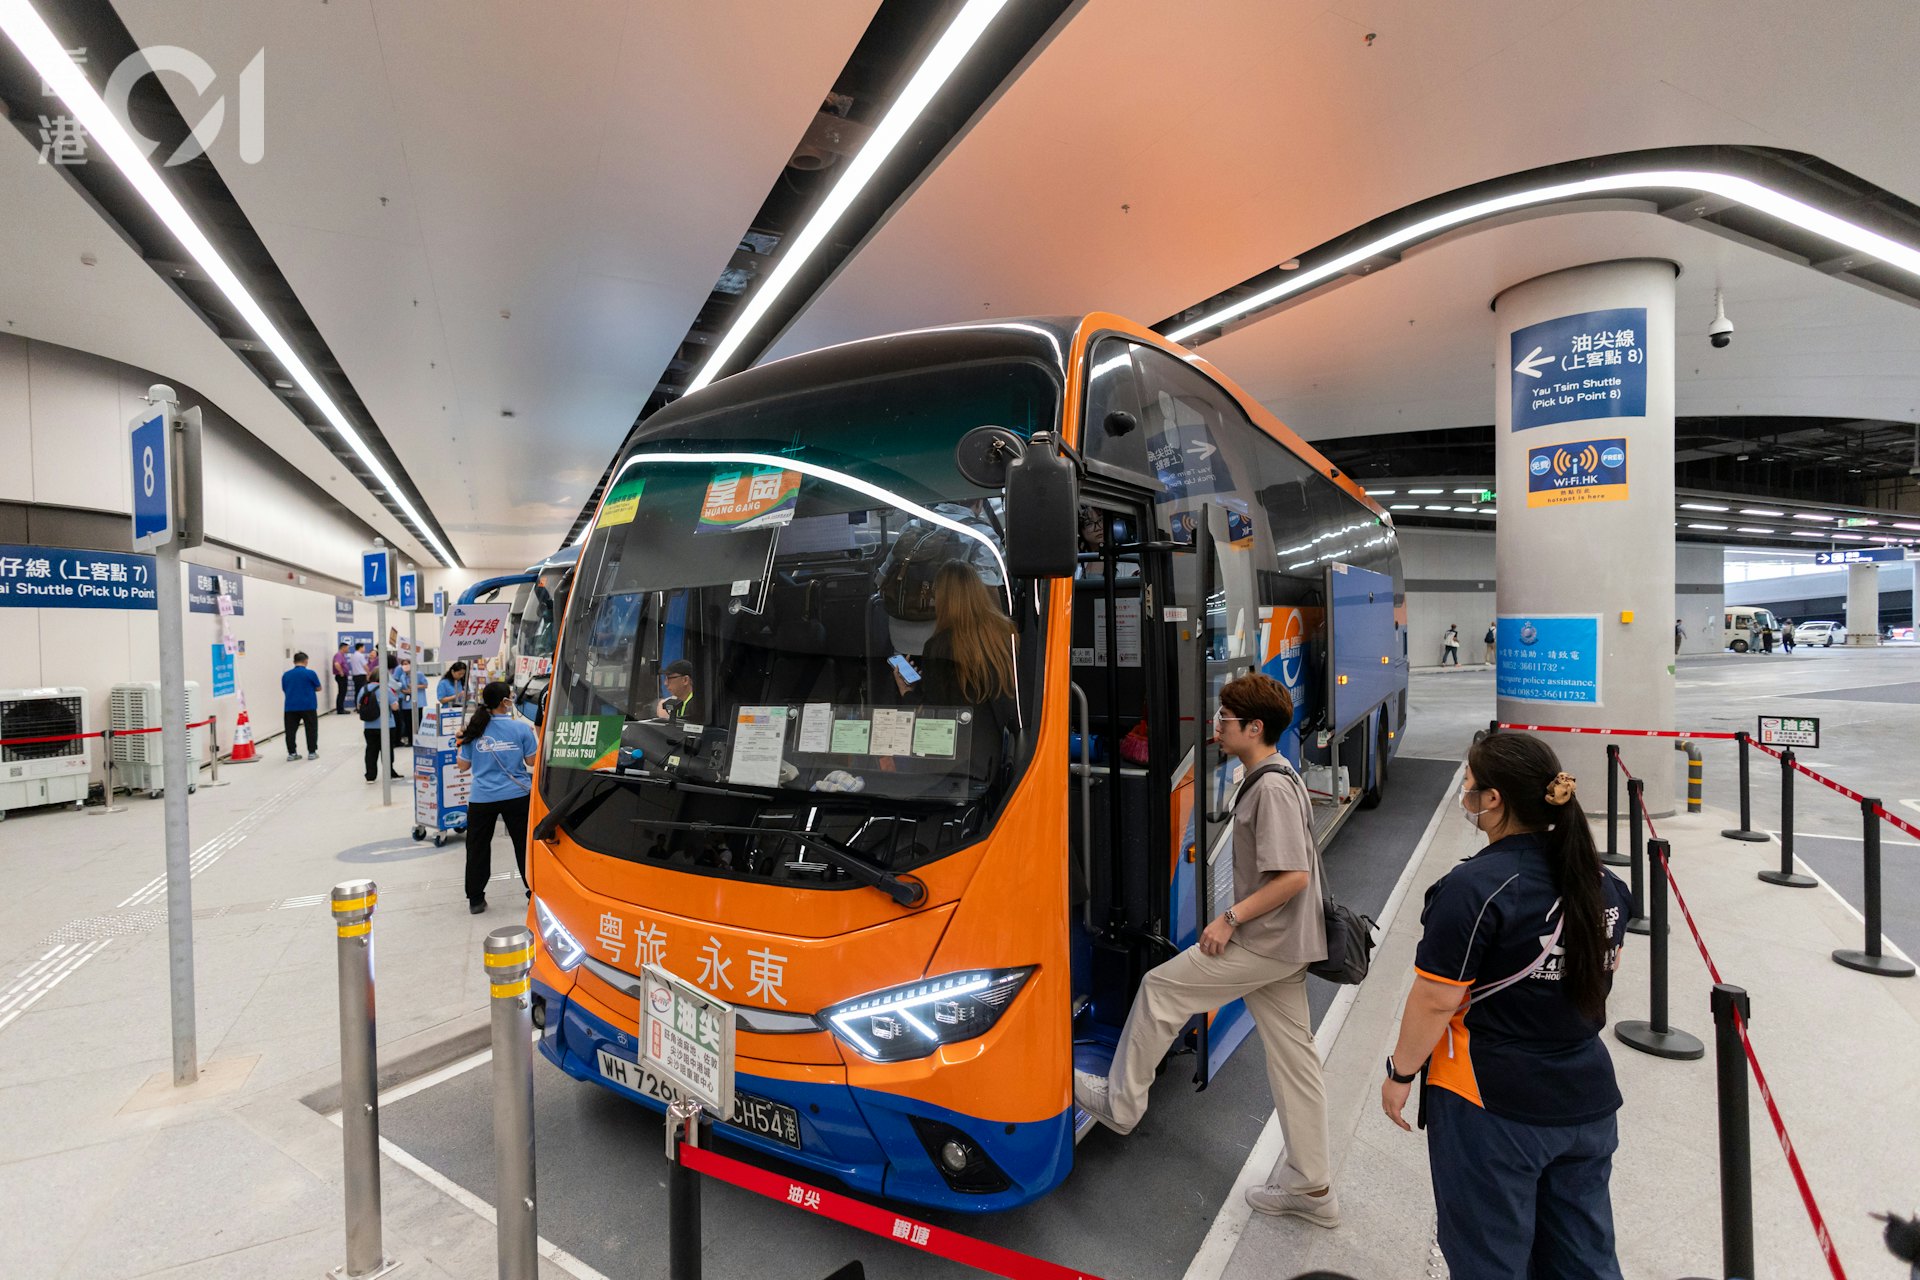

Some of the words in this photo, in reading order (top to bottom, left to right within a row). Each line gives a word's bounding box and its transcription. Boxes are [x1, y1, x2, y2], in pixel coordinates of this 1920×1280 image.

[1571, 330, 1635, 353] 油尖線
[1561, 350, 1622, 371] (上客點
[1628, 347, 1643, 365] 8)
[1532, 386, 1551, 397] Yau
[1554, 382, 1579, 393] Tsim
[1583, 377, 1621, 389] Shuttle
[1532, 399, 1556, 410] (Pick
[1559, 395, 1574, 405] Up
[1577, 391, 1606, 401] Point
[1609, 388, 1621, 400] 8)
[1531, 459, 1550, 471] 免費
[1602, 453, 1624, 461] FREE
[143, 445, 155, 498] 8
[1553, 475, 1598, 488] Wi-Fi.HK
[1547, 495, 1575, 503] hotspot
[704, 505, 734, 517] HUANG
[735, 501, 761, 513] GANG
[0, 556, 51, 579] 仔線
[59, 559, 128, 582] (上客點
[133, 565, 148, 584] 7)
[370, 562, 379, 582] 7
[16, 582, 74, 595] Shuttle
[78, 584, 110, 598] (Pick
[113, 586, 129, 599] Up
[131, 587, 156, 599] Point
[404, 581, 411, 596] 6
[436, 597, 441, 608] 5
[449, 618, 501, 637] 灣仔線
[472, 638, 488, 646] Chai
[1522, 676, 1545, 685] police
[554, 720, 600, 746] 尖沙咀
[1783, 719, 1815, 732] 油尖
[552, 748, 567, 758] TSIM
[566, 748, 579, 758] SHA
[580, 748, 597, 759] TSUI
[696, 935, 788, 1006] 永東
[1530, 971, 1563, 981] 24-HOU
[677, 995, 720, 1054] 油尖
[602, 1054, 628, 1085] WH
[787, 1183, 821, 1209] 油尖
[891, 1218, 930, 1246] 觀塘
